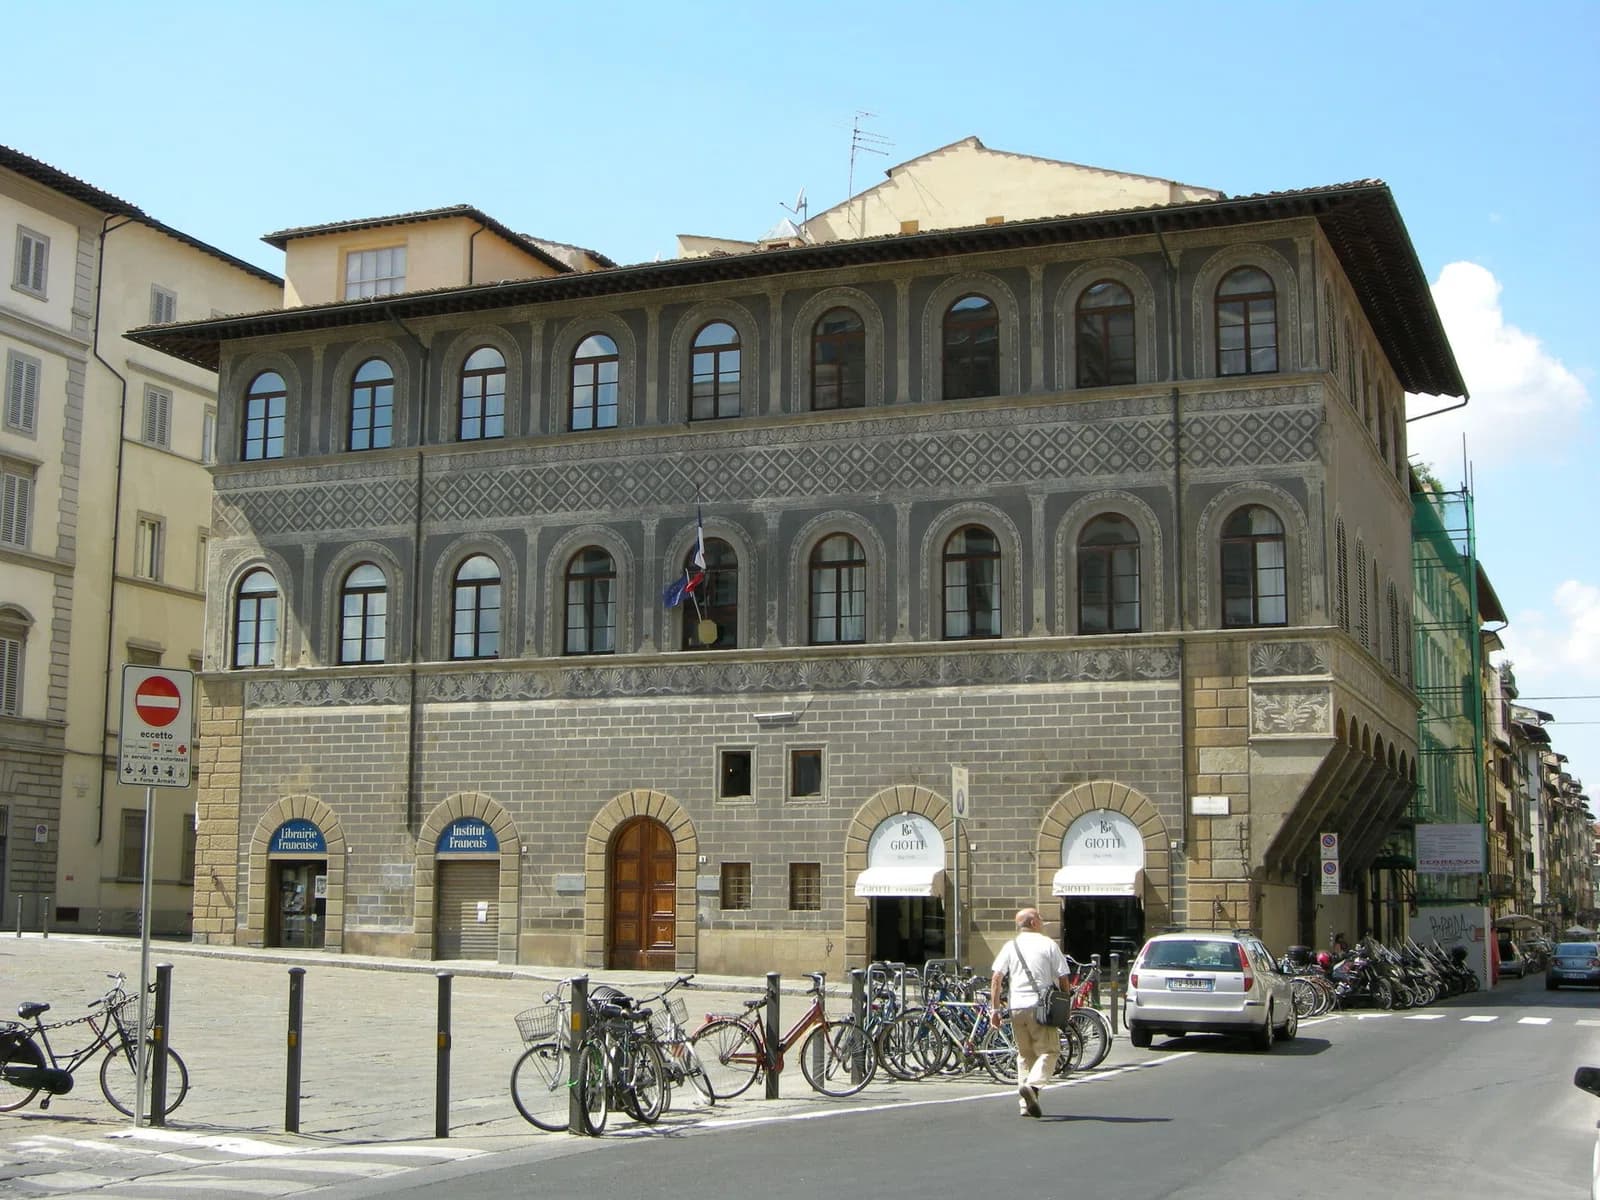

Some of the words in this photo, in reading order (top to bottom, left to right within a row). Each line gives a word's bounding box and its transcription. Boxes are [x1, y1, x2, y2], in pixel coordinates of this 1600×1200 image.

[140, 731, 173, 740] eccetto
[281, 827, 318, 839] Librairie
[453, 824, 485, 836] Institut
[890, 840, 925, 850] GIOTTI
[1084, 838, 1121, 849] GIOTTI
